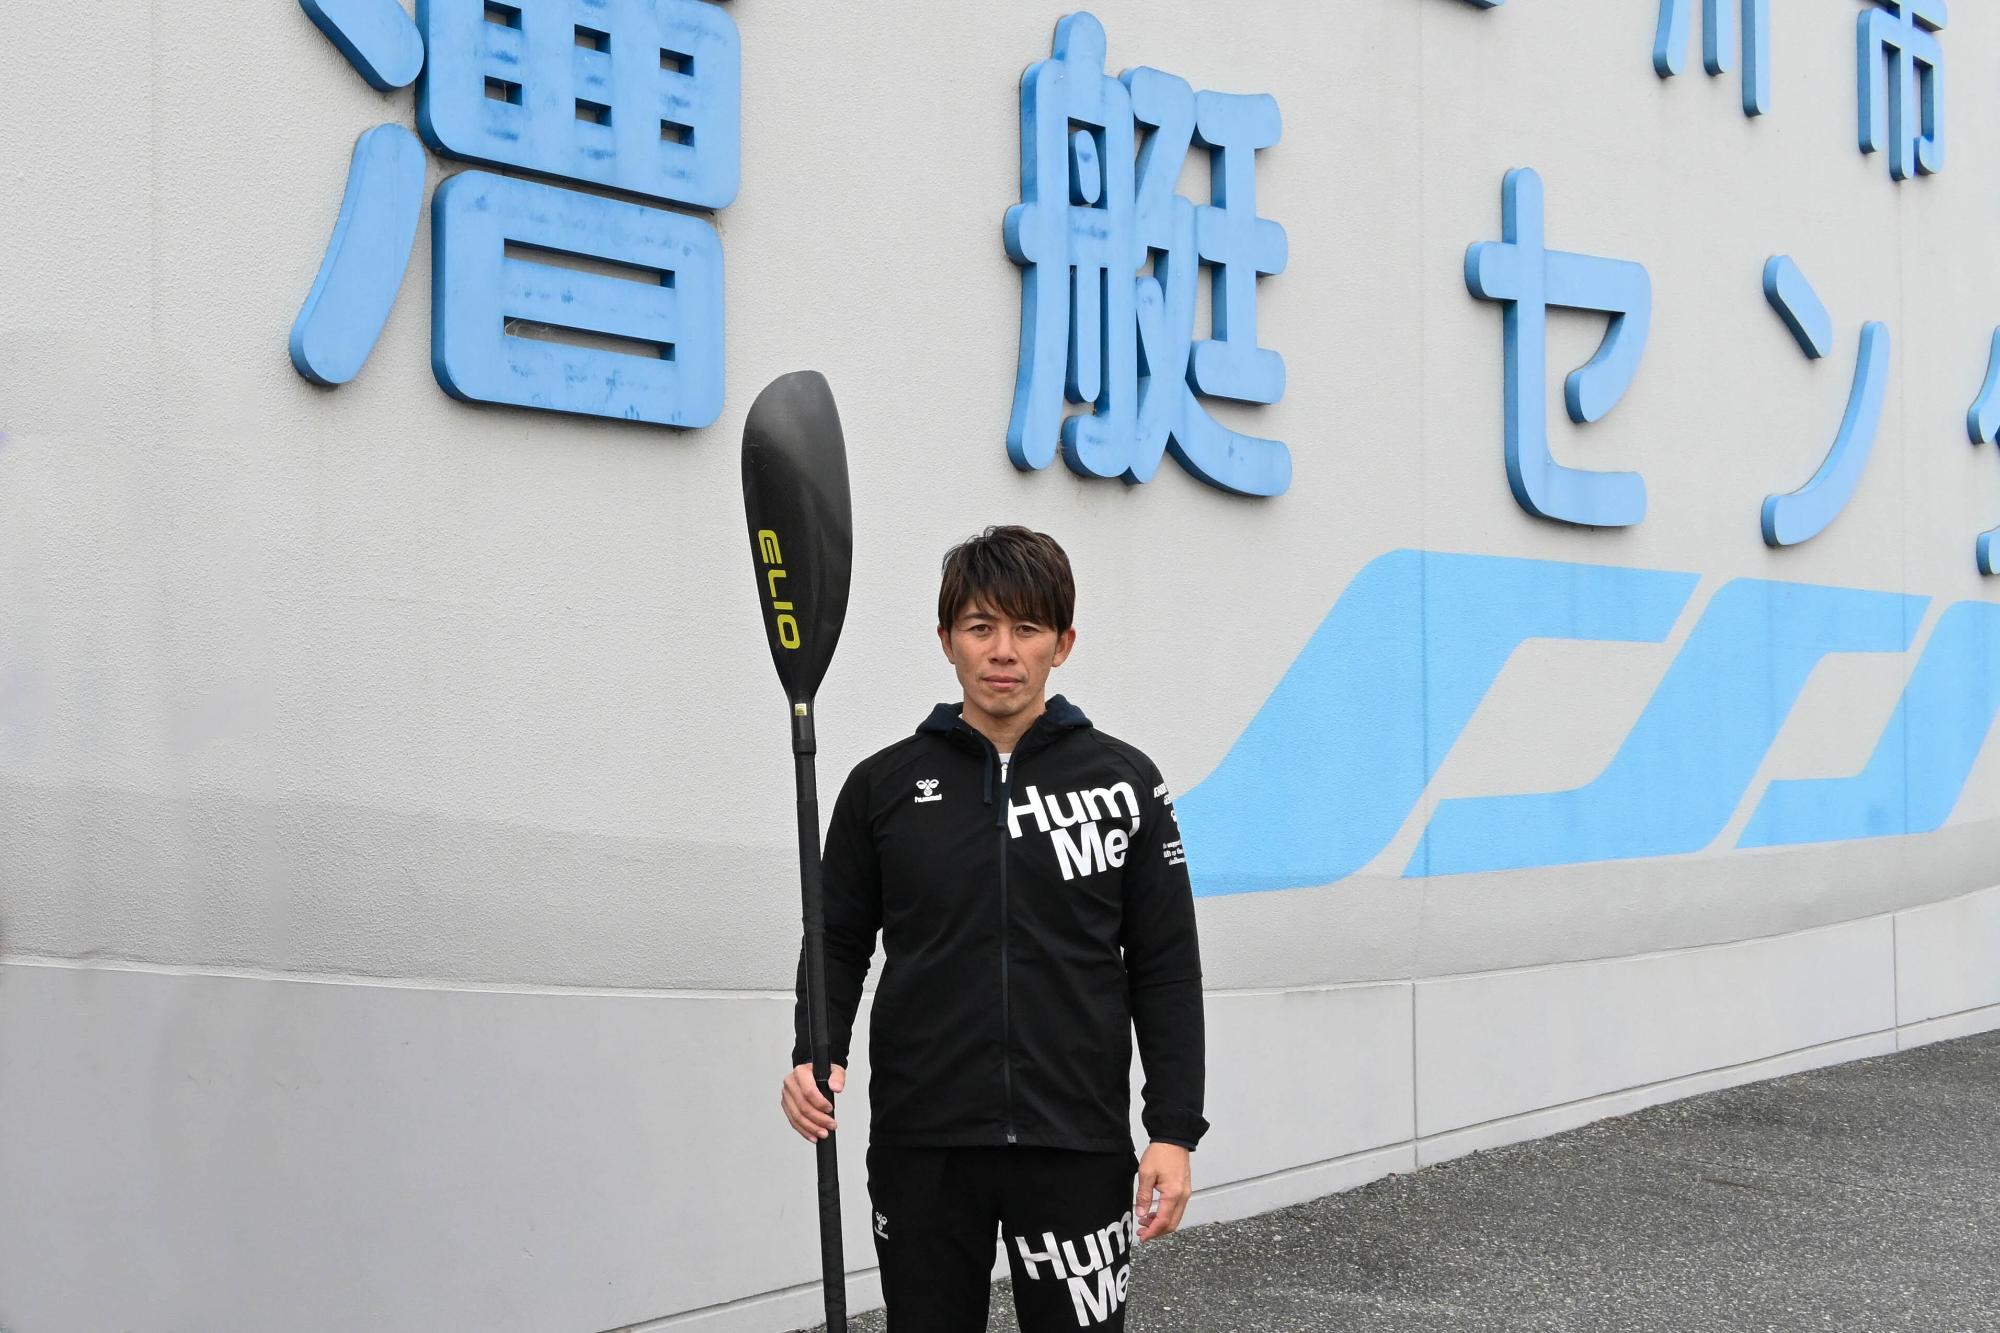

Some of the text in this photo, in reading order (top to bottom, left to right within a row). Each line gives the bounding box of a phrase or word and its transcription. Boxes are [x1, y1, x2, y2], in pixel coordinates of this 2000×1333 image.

[290, 0, 2000, 576] 漕艇セン
[758, 529, 801, 650] ELIO
[1007, 781, 1141, 839] Hum
[1050, 821, 1129, 881] Me
[1015, 1210, 1133, 1280] Hum
[1067, 1263, 1131, 1327] Me
